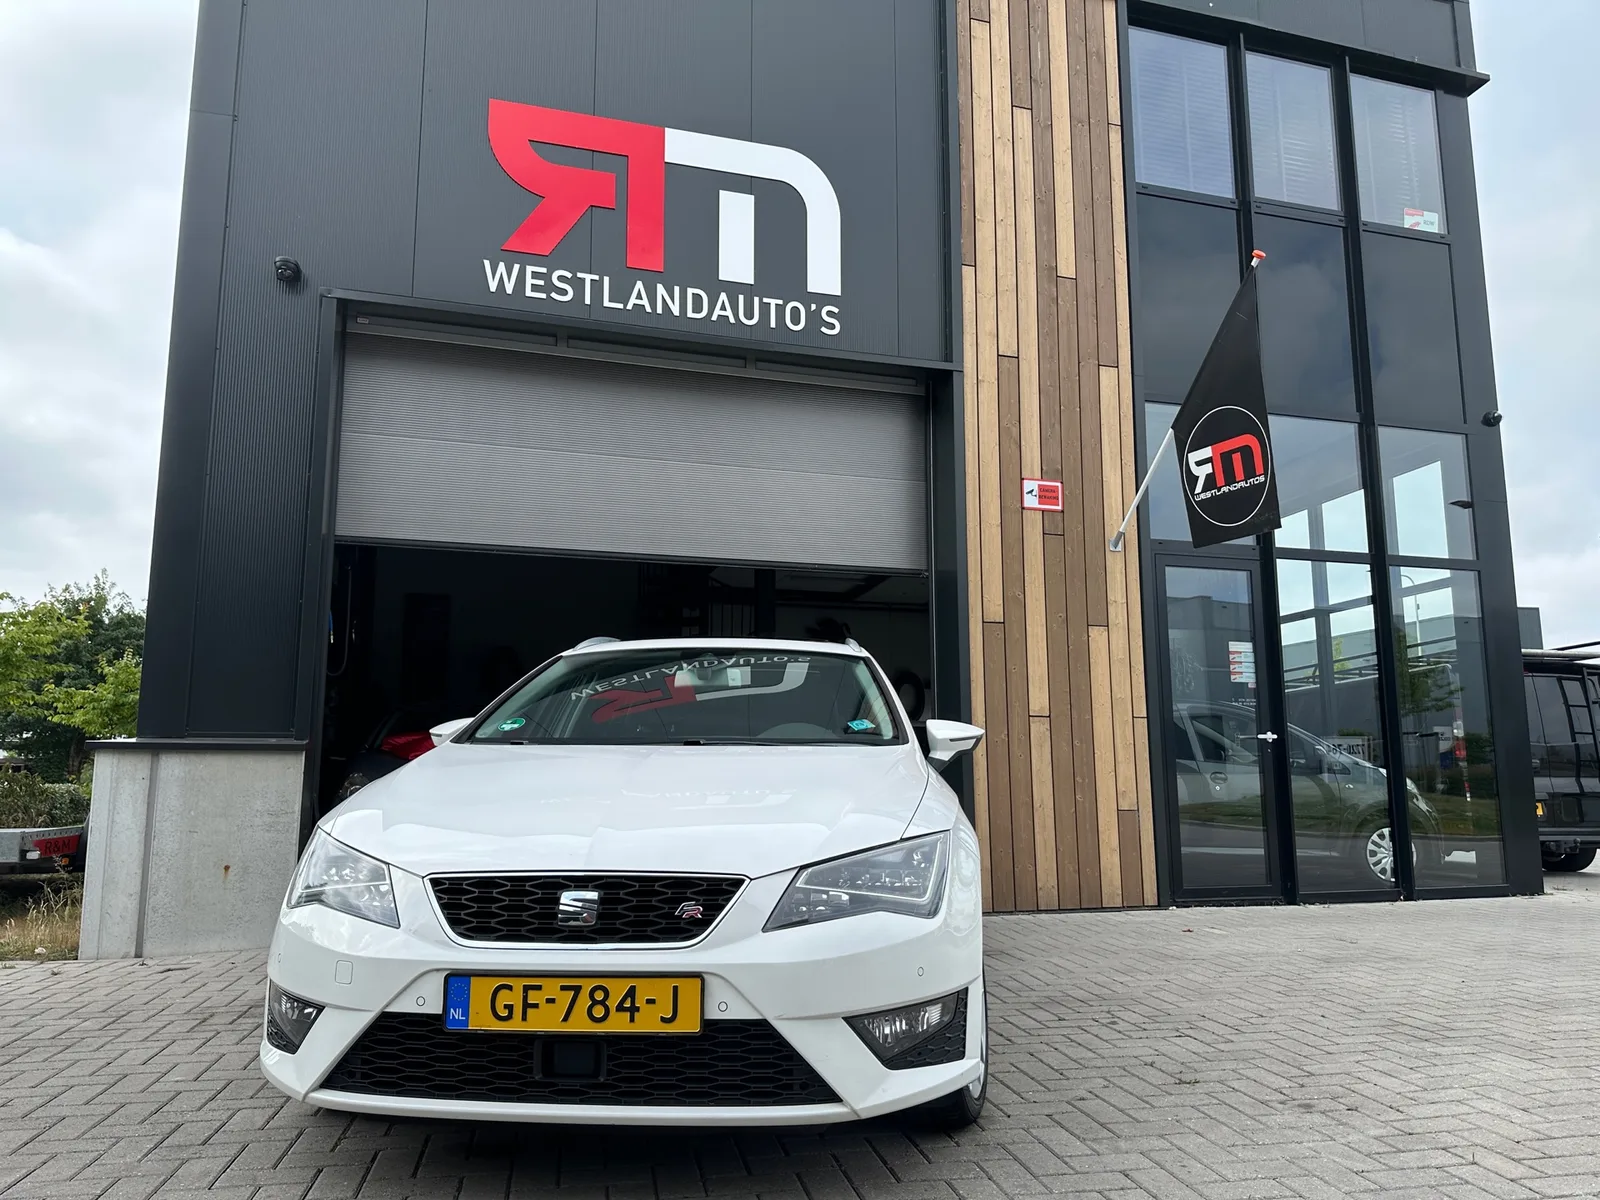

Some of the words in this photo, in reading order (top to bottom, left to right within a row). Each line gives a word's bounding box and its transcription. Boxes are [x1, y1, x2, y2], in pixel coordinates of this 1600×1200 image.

[483, 259, 841, 335] WESTLANDAUTO'S
[1194, 474, 1266, 502] WESTLANDAUTOS
[44, 840, 71, 855] R&M
[675, 901, 703, 919] FR
[449, 1007, 466, 1020] NL
[489, 982, 680, 1025] GF-784-J
